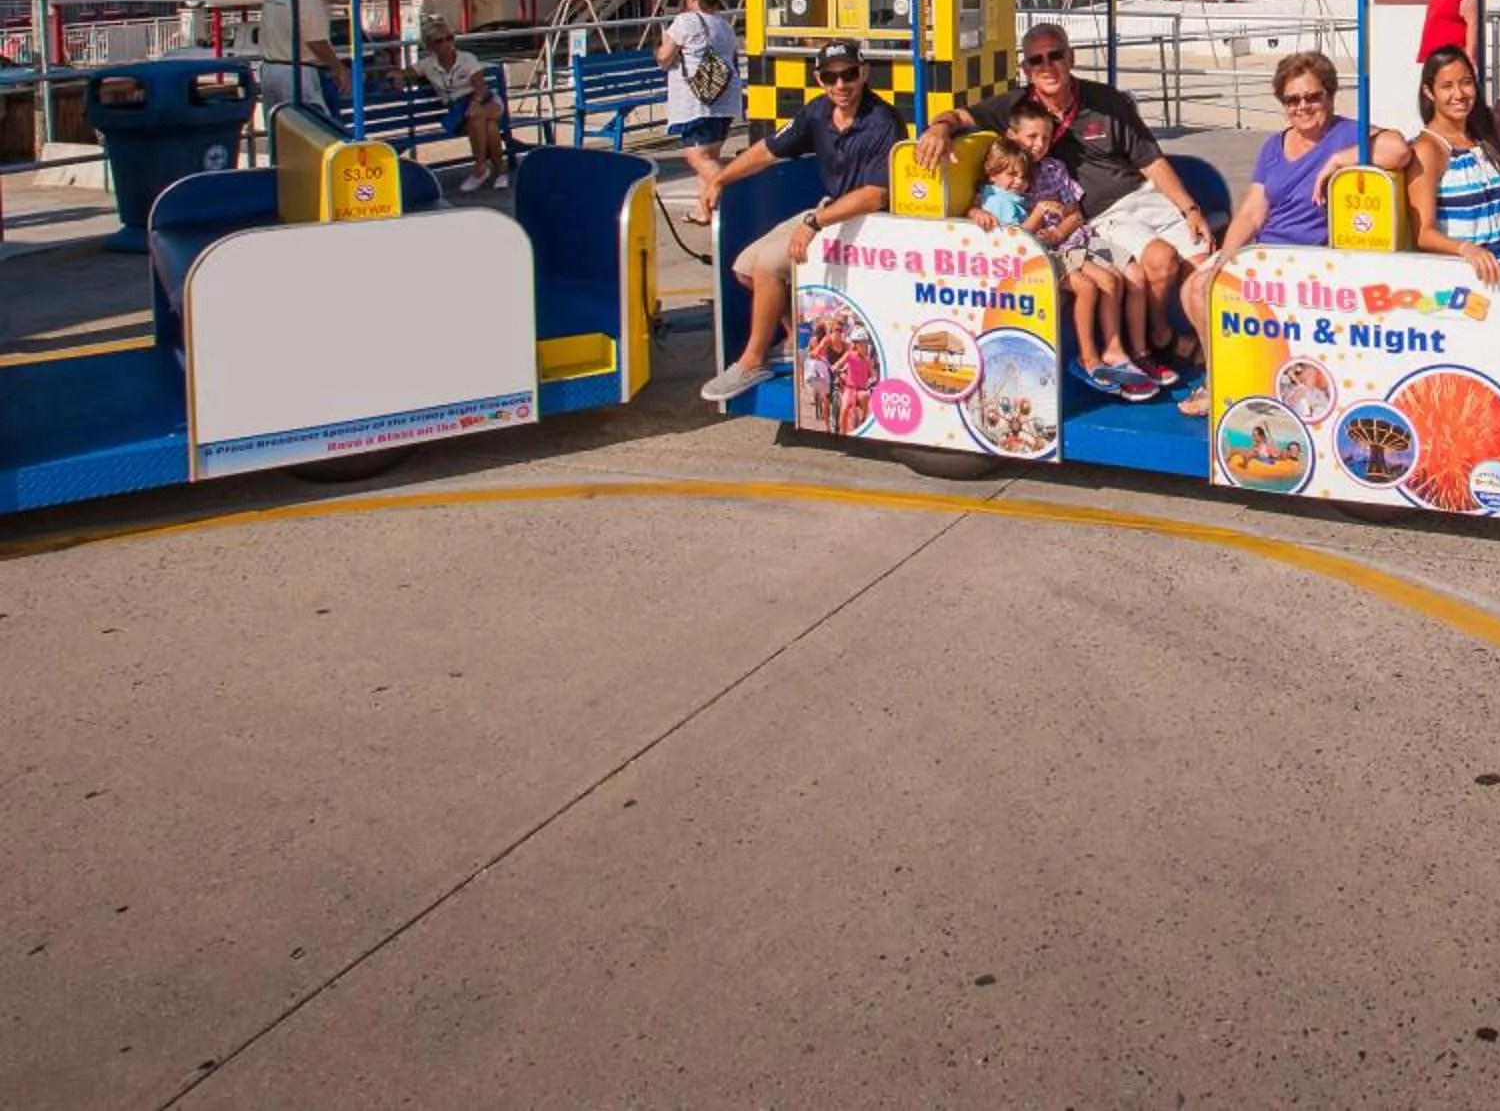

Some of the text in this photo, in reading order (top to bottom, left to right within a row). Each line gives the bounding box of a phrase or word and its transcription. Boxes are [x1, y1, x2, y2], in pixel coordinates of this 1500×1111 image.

[823, 238, 1023, 281] Have a Blast
[915, 282, 1035, 317] Morning
[1243, 279, 1287, 306] on
[1297, 279, 1358, 313] the
[1221, 311, 1447, 354] Noon & Night
